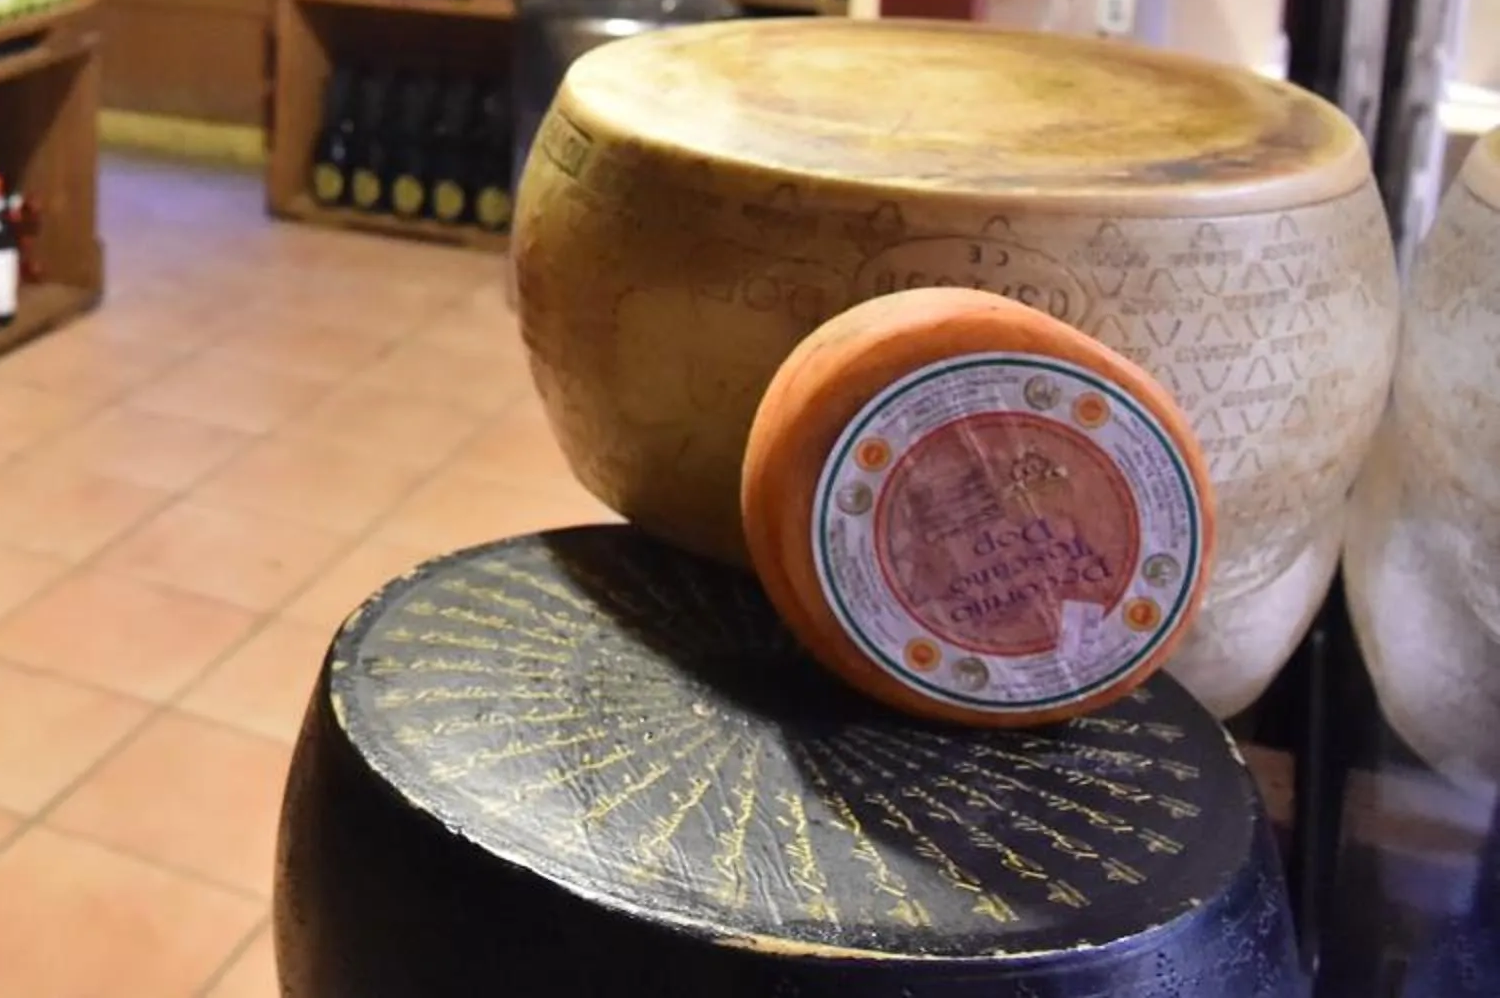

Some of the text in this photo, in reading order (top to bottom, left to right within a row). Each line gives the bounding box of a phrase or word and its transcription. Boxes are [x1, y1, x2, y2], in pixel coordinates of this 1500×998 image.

[948, 533, 1095, 597] Toscano
[972, 518, 1054, 558] Dop
[949, 555, 1113, 625] Pecorino
